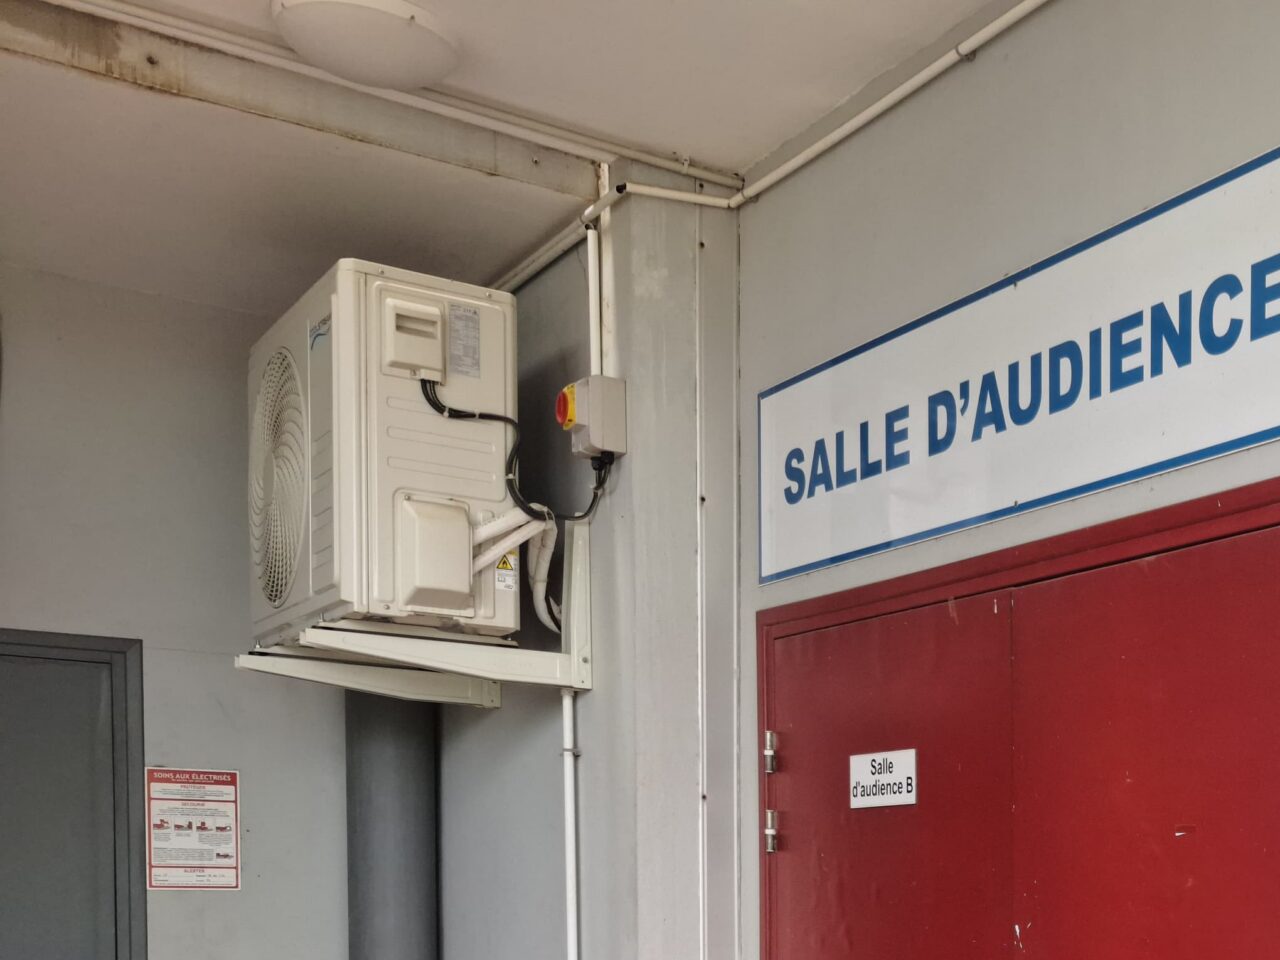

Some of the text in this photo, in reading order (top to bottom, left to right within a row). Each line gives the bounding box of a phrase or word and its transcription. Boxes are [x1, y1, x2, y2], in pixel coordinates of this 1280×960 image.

[784, 405, 910, 504] SALLE
[870, 757, 894, 776] Salle
[852, 776, 914, 798] d'audience B
